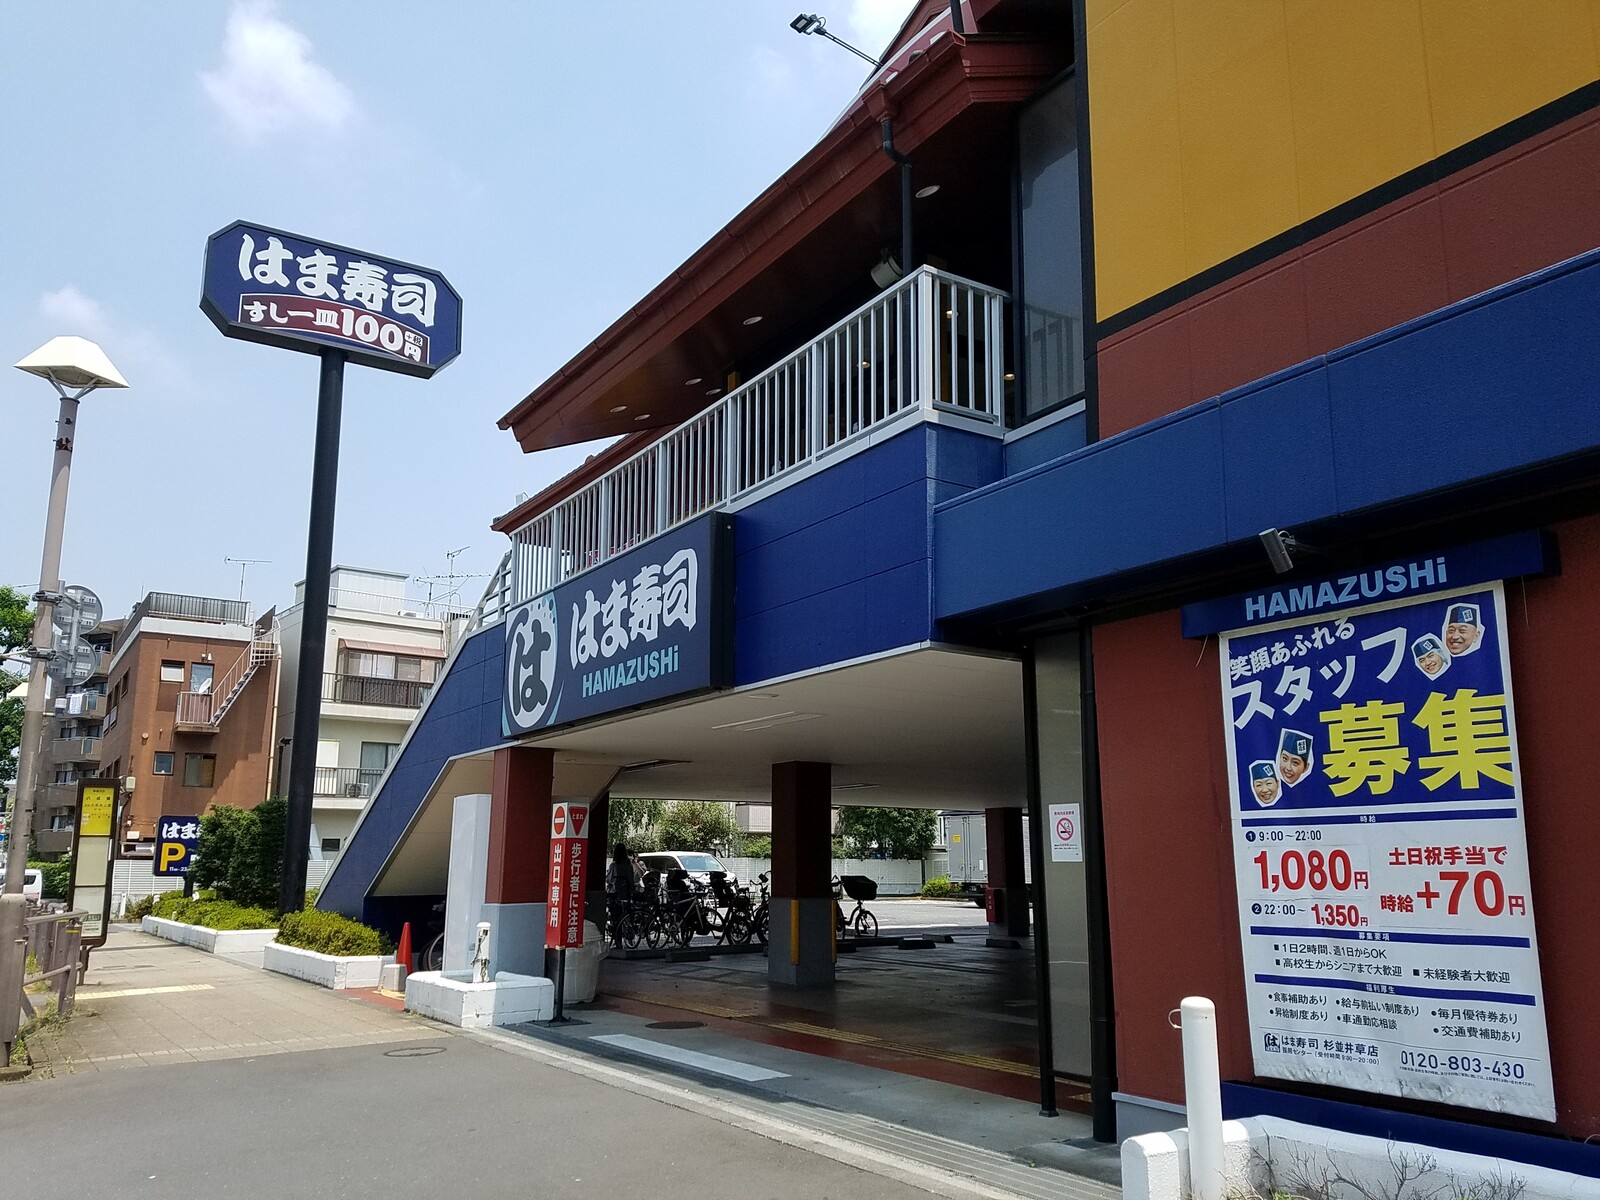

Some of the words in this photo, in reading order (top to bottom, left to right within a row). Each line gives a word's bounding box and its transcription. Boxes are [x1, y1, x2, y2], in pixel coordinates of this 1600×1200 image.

[238, 233, 437, 328] はま寿司
[1245, 556, 1448, 621] HAMAZUSHi
[569, 548, 698, 670] はま寿司
[1229, 617, 1355, 680] 笑顔あふれる
[582, 645, 679, 698] HAMAZUSHi
[1230, 626, 1408, 729] スタッフ
[1319, 688, 1515, 797] 募集
[160, 842, 186, 872] P
[1389, 846, 1508, 866] 土日祝手当で
[550, 843, 562, 928] 出口専用
[1253, 849, 1369, 893] 1,080円
[567, 842, 582, 943] 歩行者に注意
[1283, 958, 1403, 978] 高校生からシニアまで大歓迎
[1423, 968, 1511, 984] 未経験者大歓迎
[1273, 992, 1327, 1006] 食事補助あり
[1341, 997, 1419, 1017] 給与前払い制度あり
[1274, 1007, 1328, 1022] 昇給制度あり
[1342, 1013, 1398, 1031] 車通勤応相談
[1437, 1007, 1518, 1025] 毎月優待券あり
[1281, 1035, 1319, 1050] はま寿司
[1323, 1039, 1379, 1058] 杉並井草店
[1441, 1025, 1521, 1043] 交通費補助あり
[1401, 1050, 1525, 1079] 0120-803-430
